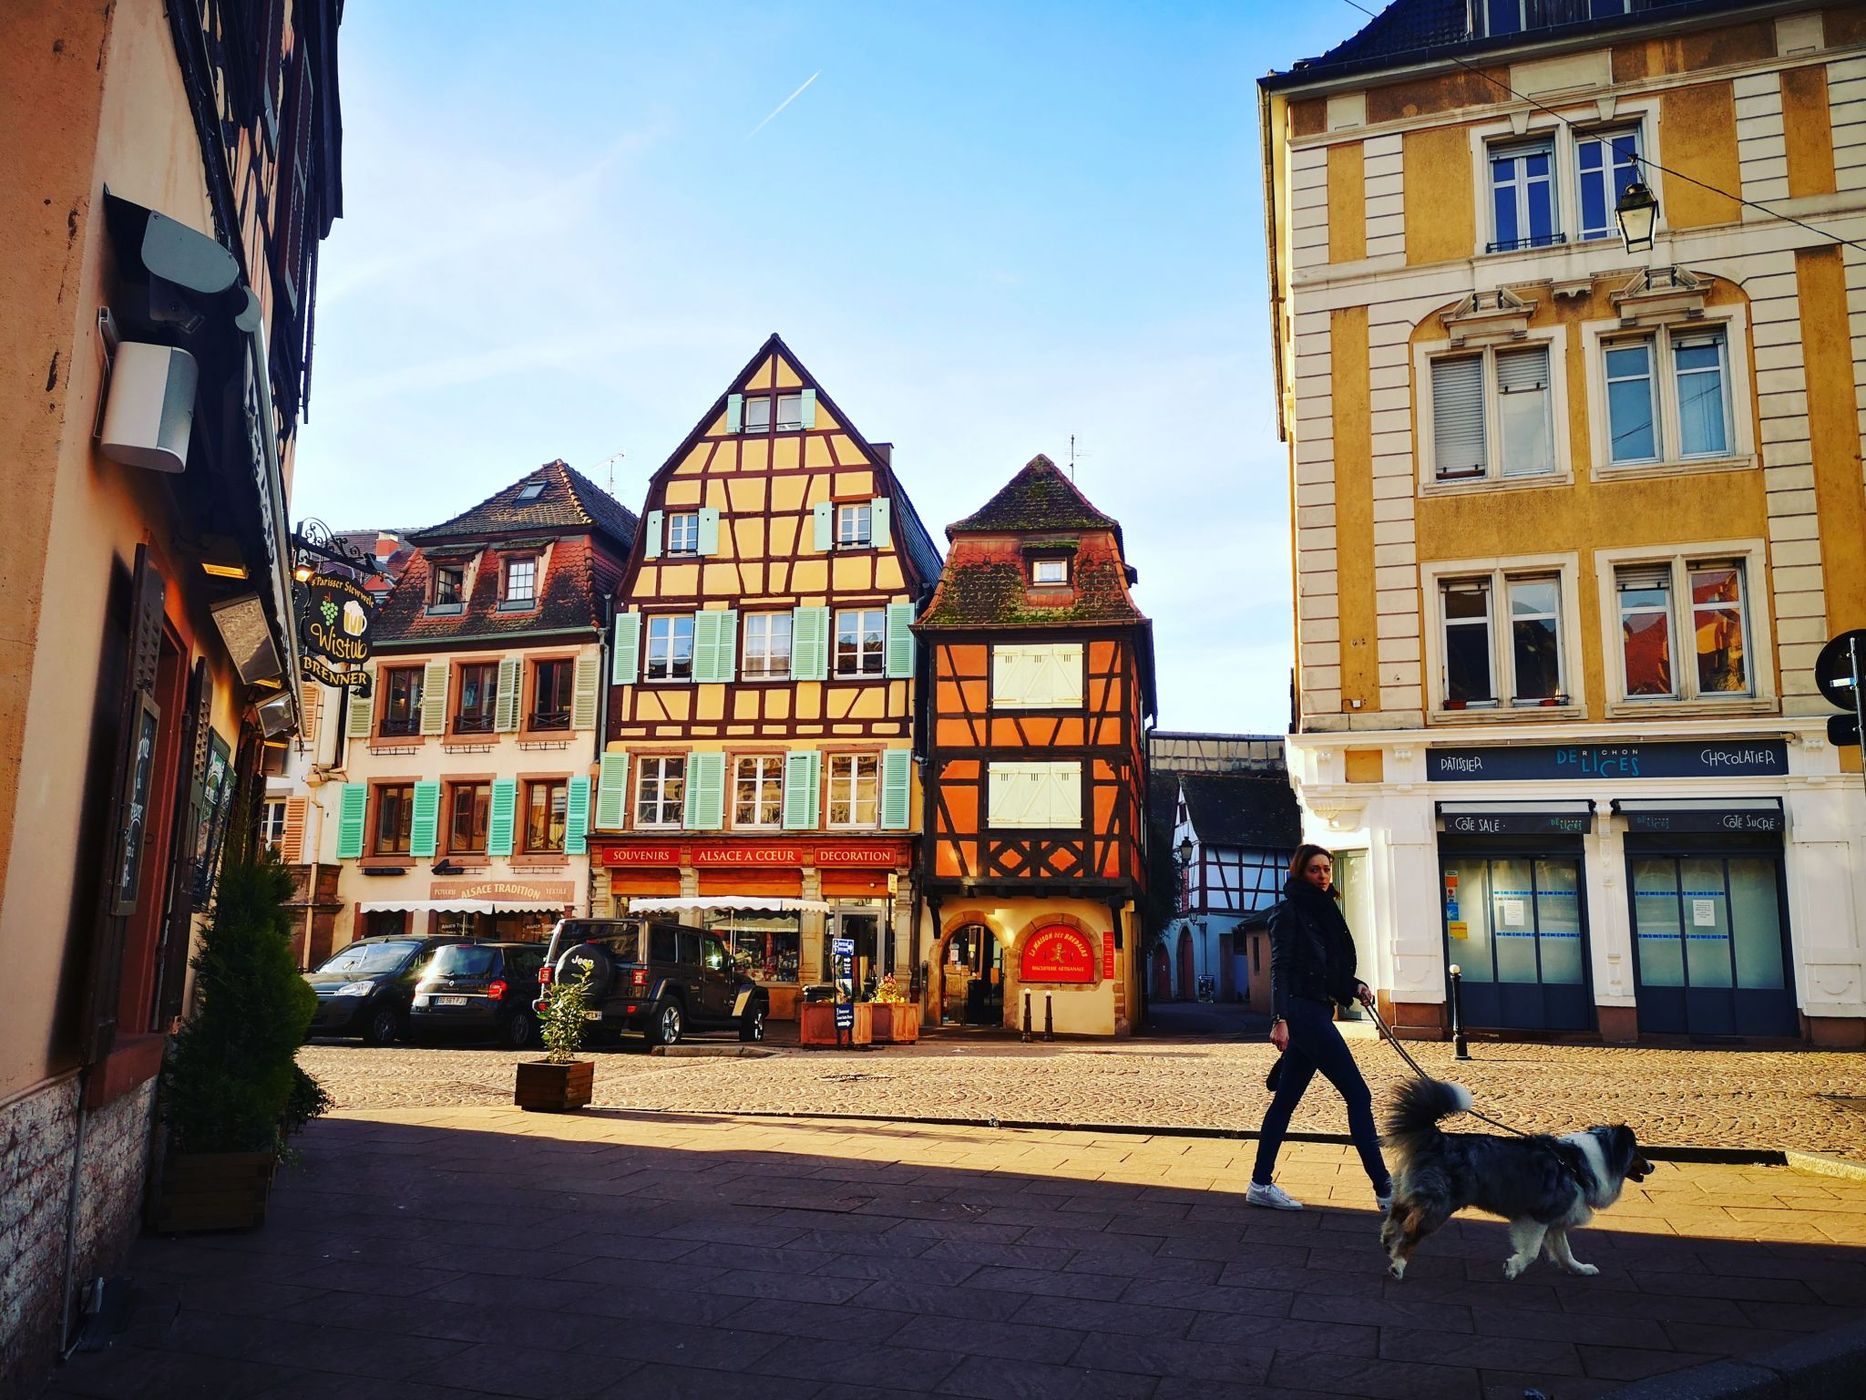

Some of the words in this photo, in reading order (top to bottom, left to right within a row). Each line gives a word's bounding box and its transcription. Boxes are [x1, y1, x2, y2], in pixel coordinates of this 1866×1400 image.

[310, 622, 367, 659] Wistub
[303, 656, 367, 685] BRENNER
[1700, 748, 1776, 767] CHOCOLATIER
[613, 851, 670, 861] SOUVENIRS
[698, 850, 742, 862] ALSACE
[755, 850, 796, 862] CŒUR
[820, 851, 890, 861] DECORATION
[461, 884, 493, 899] ALSACE
[494, 883, 541, 900] TRADITION
